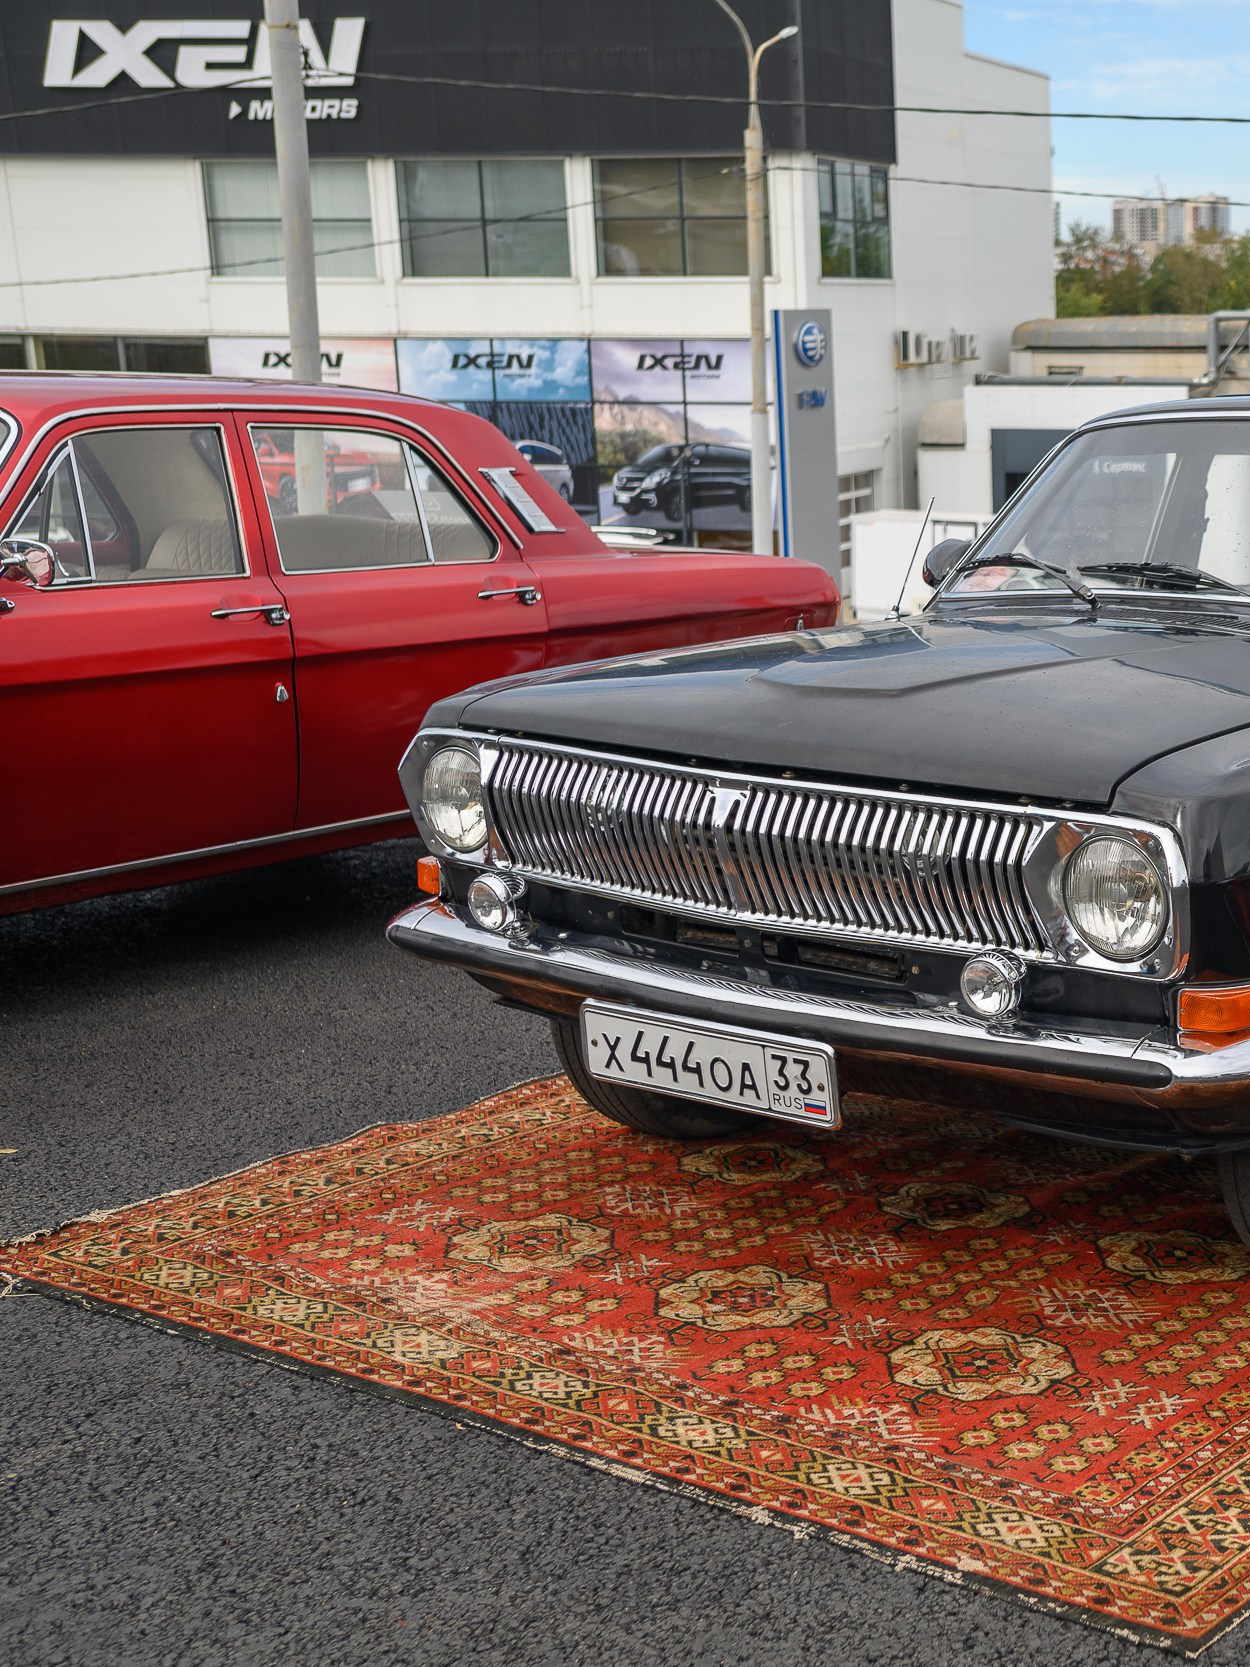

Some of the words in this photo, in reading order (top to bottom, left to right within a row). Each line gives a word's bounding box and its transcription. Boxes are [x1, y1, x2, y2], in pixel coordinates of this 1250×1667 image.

[249, 98, 359, 120] MORS
[262, 352, 344, 369] IXN
[451, 352, 535, 370] IXEN
[637, 354, 724, 371] IXEN
[770, 1053, 813, 1097] 33
[772, 1093, 804, 1111] RUS
